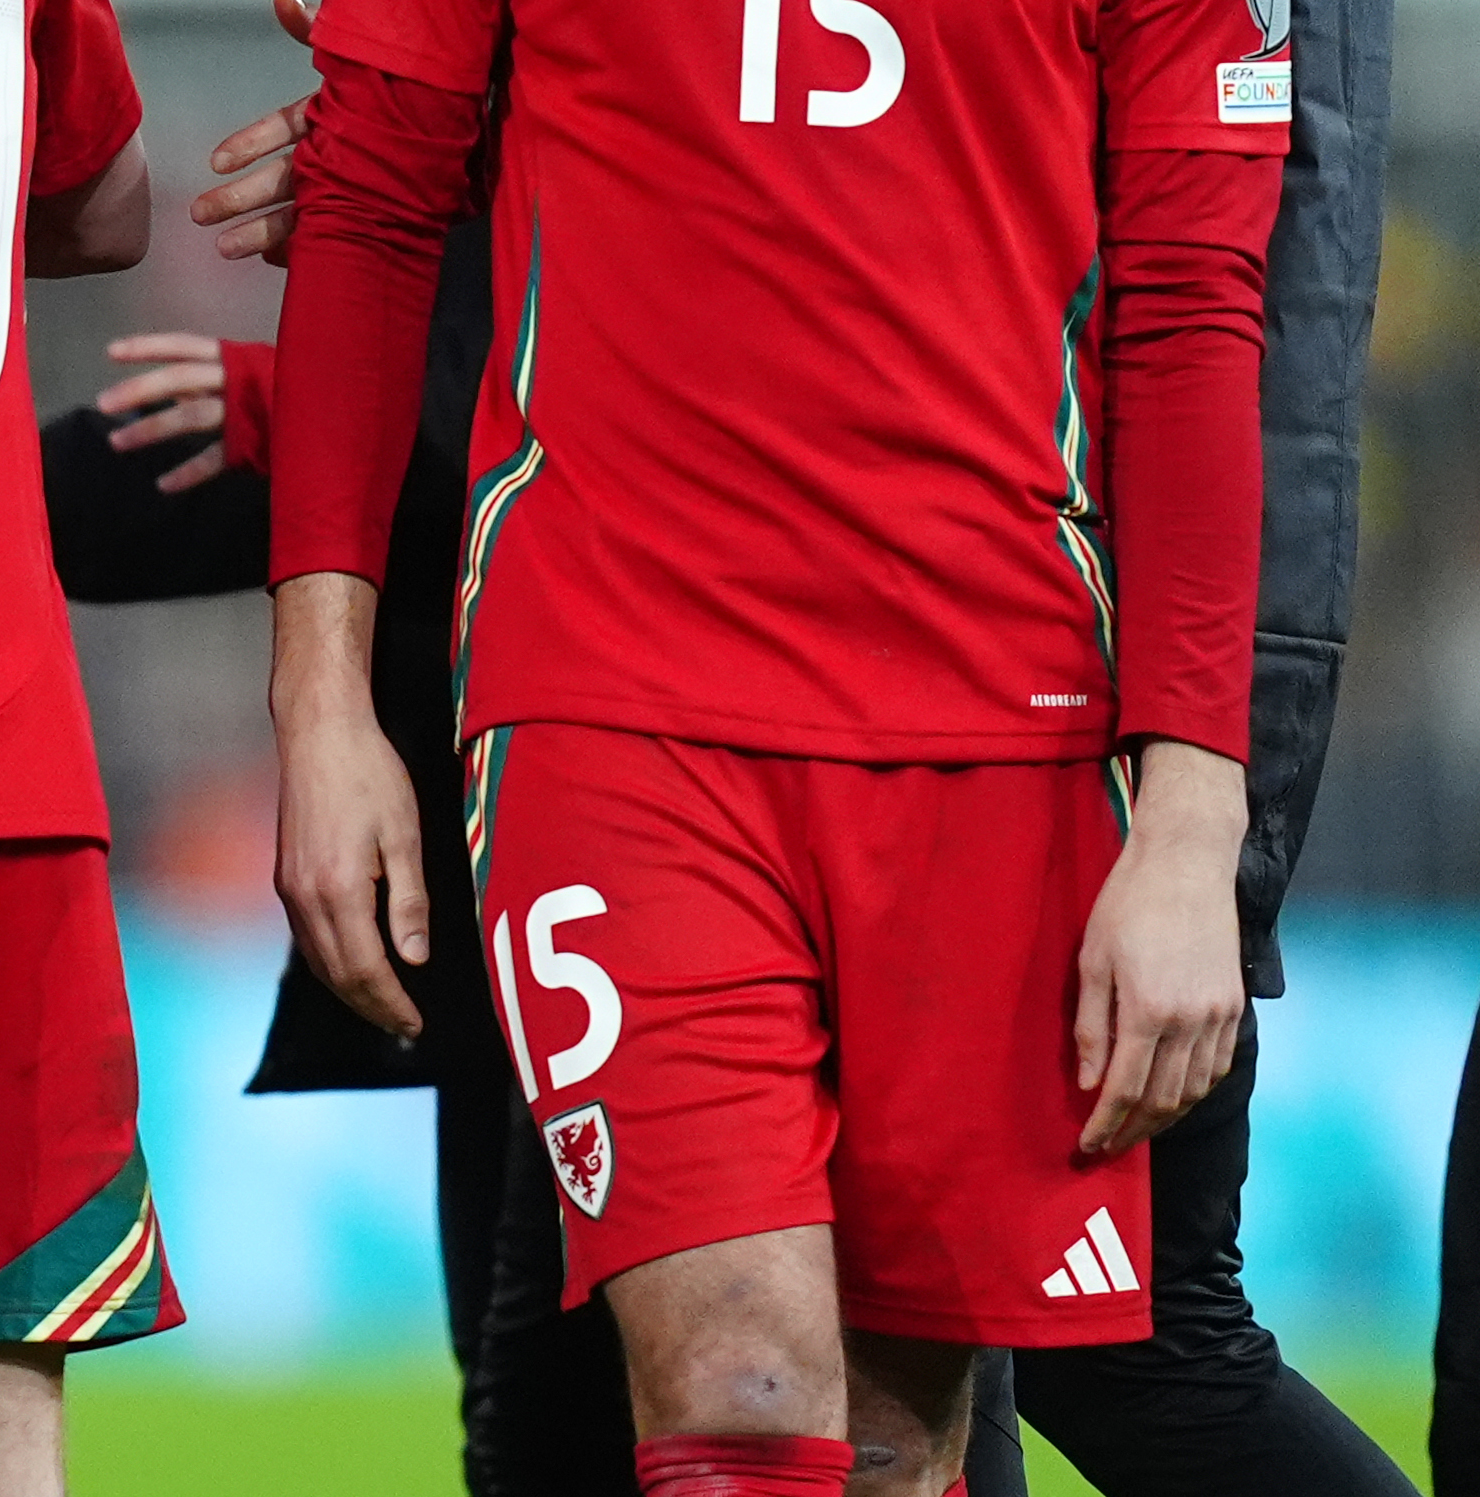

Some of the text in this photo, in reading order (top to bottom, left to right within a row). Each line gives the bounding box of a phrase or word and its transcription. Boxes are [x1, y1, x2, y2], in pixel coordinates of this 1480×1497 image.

[1223, 67, 1254, 80] UEFA
[1030, 694, 1088, 707] AEROREADY
[493, 884, 623, 1104] 15
